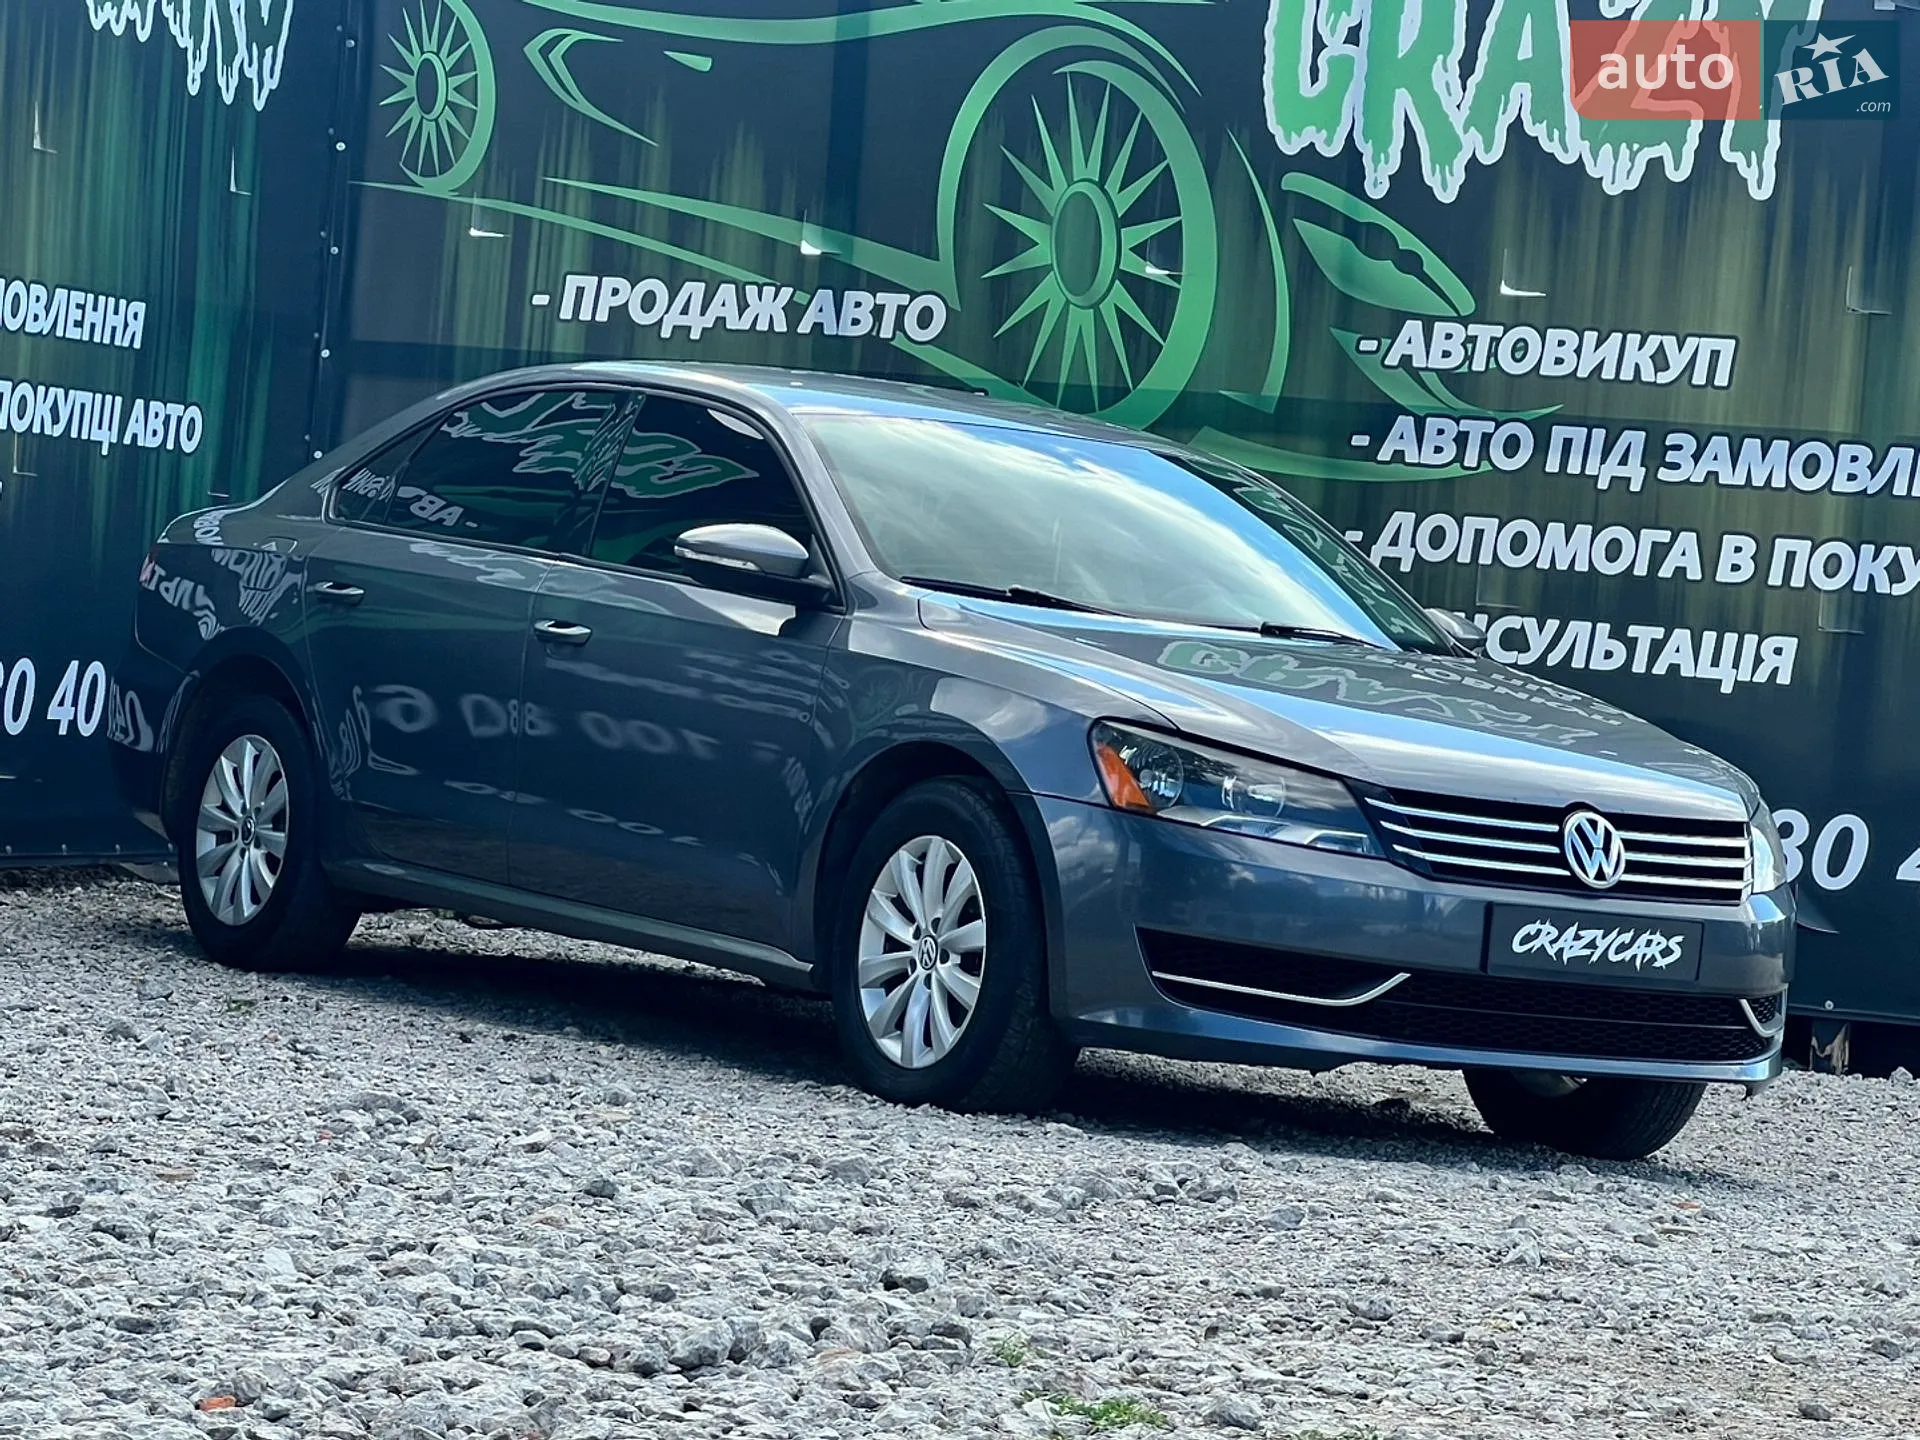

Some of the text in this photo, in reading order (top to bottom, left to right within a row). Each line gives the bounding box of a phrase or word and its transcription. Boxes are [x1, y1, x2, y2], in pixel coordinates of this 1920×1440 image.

[0, 278, 146, 349] ОВЛЕННЯ
[558, 274, 794, 340] ПРОДАЖ
[797, 288, 948, 342] АВТО
[1384, 319, 1736, 388] АВТОВИКУП
[123, 398, 203, 454] АВТО
[1376, 415, 1535, 472] АВТО
[1544, 425, 1647, 492] ПІД
[1656, 432, 1920, 497] ЗАМОВЛ
[1370, 510, 1703, 582] ДОПОМОГА
[1715, 533, 1757, 584] В
[1767, 537, 1920, 597] ПОКУ
[0, 657, 36, 736] 0
[46, 660, 107, 737] 40
[1511, 918, 1686, 972] CRAZYCARS
